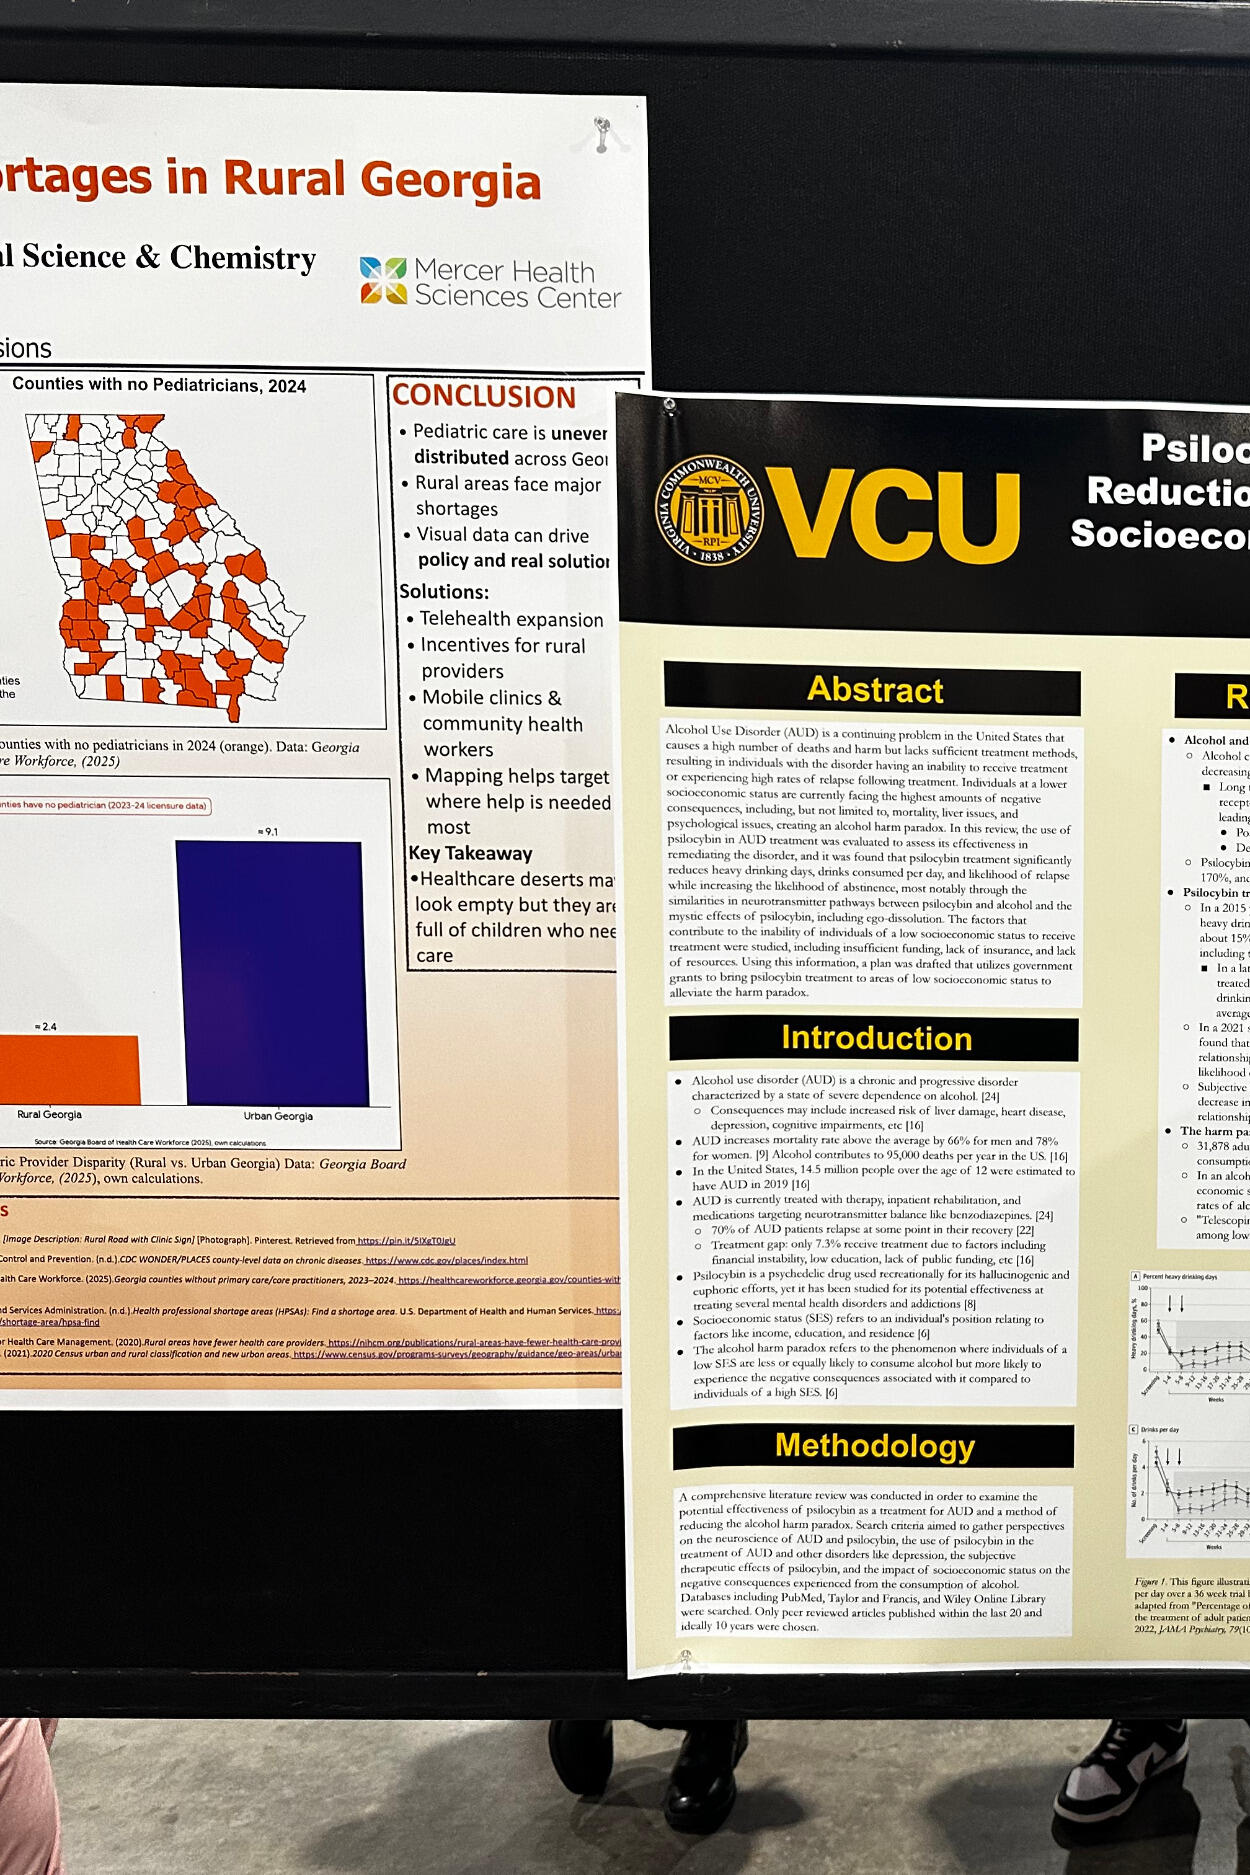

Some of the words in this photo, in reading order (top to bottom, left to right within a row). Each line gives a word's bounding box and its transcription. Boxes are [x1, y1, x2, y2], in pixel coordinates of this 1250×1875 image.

[0, 156, 152, 203] rtages
[166, 156, 207, 194] in
[224, 158, 344, 196] Rural
[361, 160, 541, 208] Georgia
[23, 242, 126, 268] Science
[135, 243, 160, 269] &
[170, 244, 316, 277] Chemistry
[415, 258, 504, 282] Mercer
[513, 259, 594, 283] Health
[415, 283, 528, 308] Sciences
[537, 286, 622, 309] Center
[12, 375, 84, 390] Counties
[88, 376, 122, 391] with
[127, 380, 148, 391] no
[153, 377, 263, 395] Pediatricians,
[268, 378, 306, 393] 2024
[392, 382, 575, 408] CONCLUSION
[414, 422, 488, 439] Pediatric
[492, 428, 528, 440] care
[533, 425, 546, 440] is
[416, 474, 458, 490] Rural
[464, 479, 509, 491] areas
[513, 475, 548, 492] face
[554, 477, 602, 496] major
[661, 459, 750, 499] COMMONWEALTH
[699, 475, 721, 485] MCV
[731, 487, 761, 556] UNIVERSITY
[765, 467, 1021, 565] VCU
[660, 502, 690, 556] VIRGINIA
[703, 537, 721, 547] RPI
[700, 551, 725, 562] 1838
[399, 582, 488, 600] Solutions:
[807, 674, 944, 704] Abstract
[665, 723, 708, 735] Alcohol
[711, 725, 732, 735] Use
[735, 725, 781, 736] Disorder
[783, 727, 818, 740] (AUD)
[841, 731, 896, 742] continuing
[898, 729, 941, 742] problem
[956, 730, 972, 741] the
[976, 731, 1010, 742] United
[1012, 731, 1042, 742] States
[1045, 732, 1064, 742] that
[1184, 734, 1226, 745] Alcohol
[1228, 736, 1249, 745] and
[409, 845, 440, 863] Key
[444, 844, 533, 864] Takeaway
[783, 1024, 972, 1051] Introduction
[17, 1109, 40, 1119] Rural
[42, 1109, 82, 1121] Georgia
[1180, 1126, 1202, 1135] The
[1204, 1126, 1233, 1136] harm
[19, 1155, 69, 1173] Provider
[72, 1156, 126, 1173] Disparity
[129, 1156, 166, 1170] (Rural
[170, 1159, 186, 1174] vs.
[191, 1157, 226, 1168] Urban
[230, 1157, 280, 1171] Georgia)
[284, 1157, 314, 1169] Data:
[319, 1158, 366, 1172] Georgia
[370, 1158, 407, 1169] Board
[692, 1181, 716, 1191] have
[720, 1179, 748, 1189] AUD
[764, 1179, 788, 1189] 2019
[791, 1179, 810, 1191] [16]
[776, 1432, 976, 1465] Methodology
[681, 1620, 712, 1632] ideally
[716, 1620, 728, 1630] 10
[730, 1623, 754, 1632] years
[782, 1621, 818, 1632] chosen.
